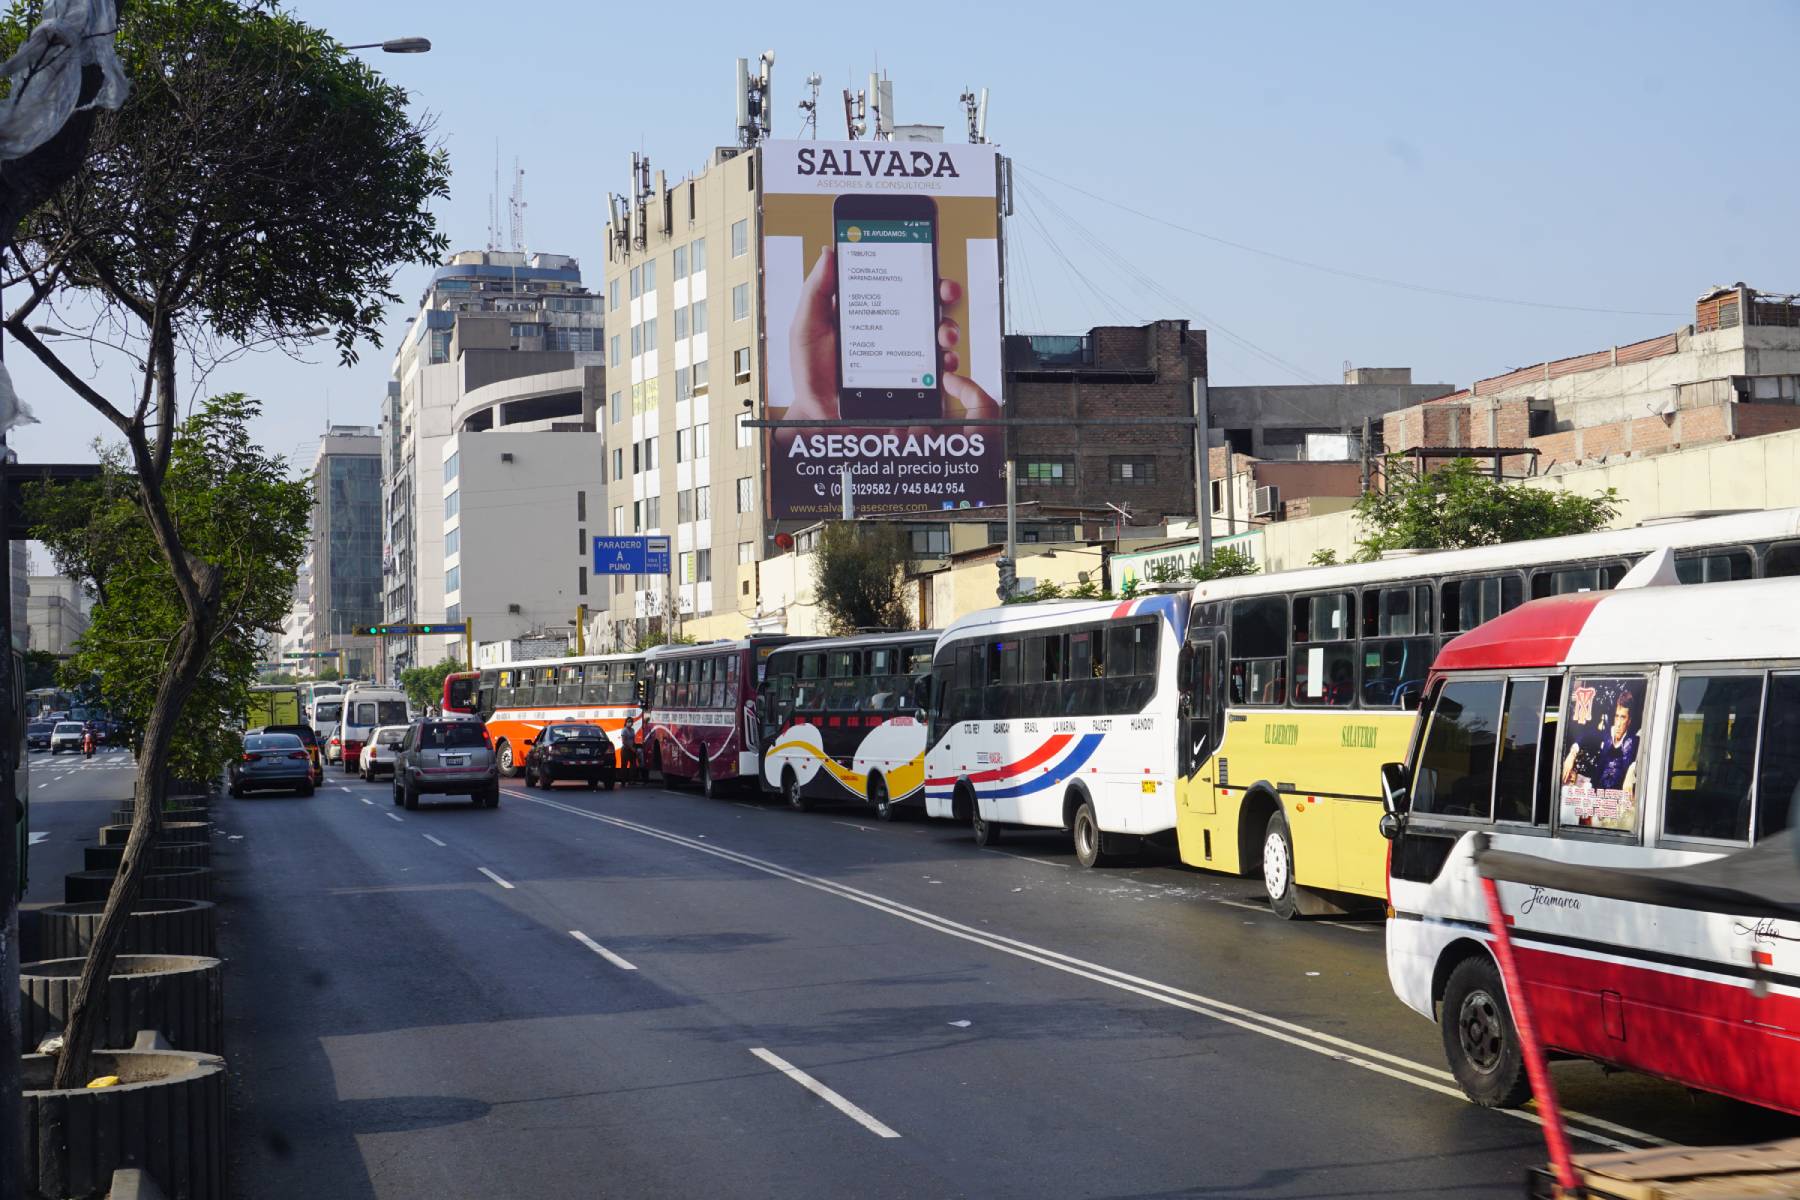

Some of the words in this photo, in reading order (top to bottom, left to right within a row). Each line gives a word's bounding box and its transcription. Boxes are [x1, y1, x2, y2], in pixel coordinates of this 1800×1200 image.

[797, 148, 960, 178] SALVADA
[816, 179, 863, 189] ASESORES
[865, 180, 873, 188] &
[875, 180, 942, 190] CONSULTORES
[788, 434, 985, 458] ASESORAMOS
[796, 462, 825, 476] Con
[882, 461, 894, 475] al
[898, 462, 942, 478] precio
[943, 462, 979, 477] justo
[902, 483, 923, 494] 945
[924, 483, 943, 494] 842
[946, 483, 965, 494] 954
[790, 503, 928, 513] www.salva-asesores.com
[598, 541, 641, 549] PARADERO
[616, 551, 624, 561] A
[608, 563, 631, 571] PUNO
[1342, 725, 1378, 748] SALAVERRY
[1521, 885, 1581, 914] Jicamarca
